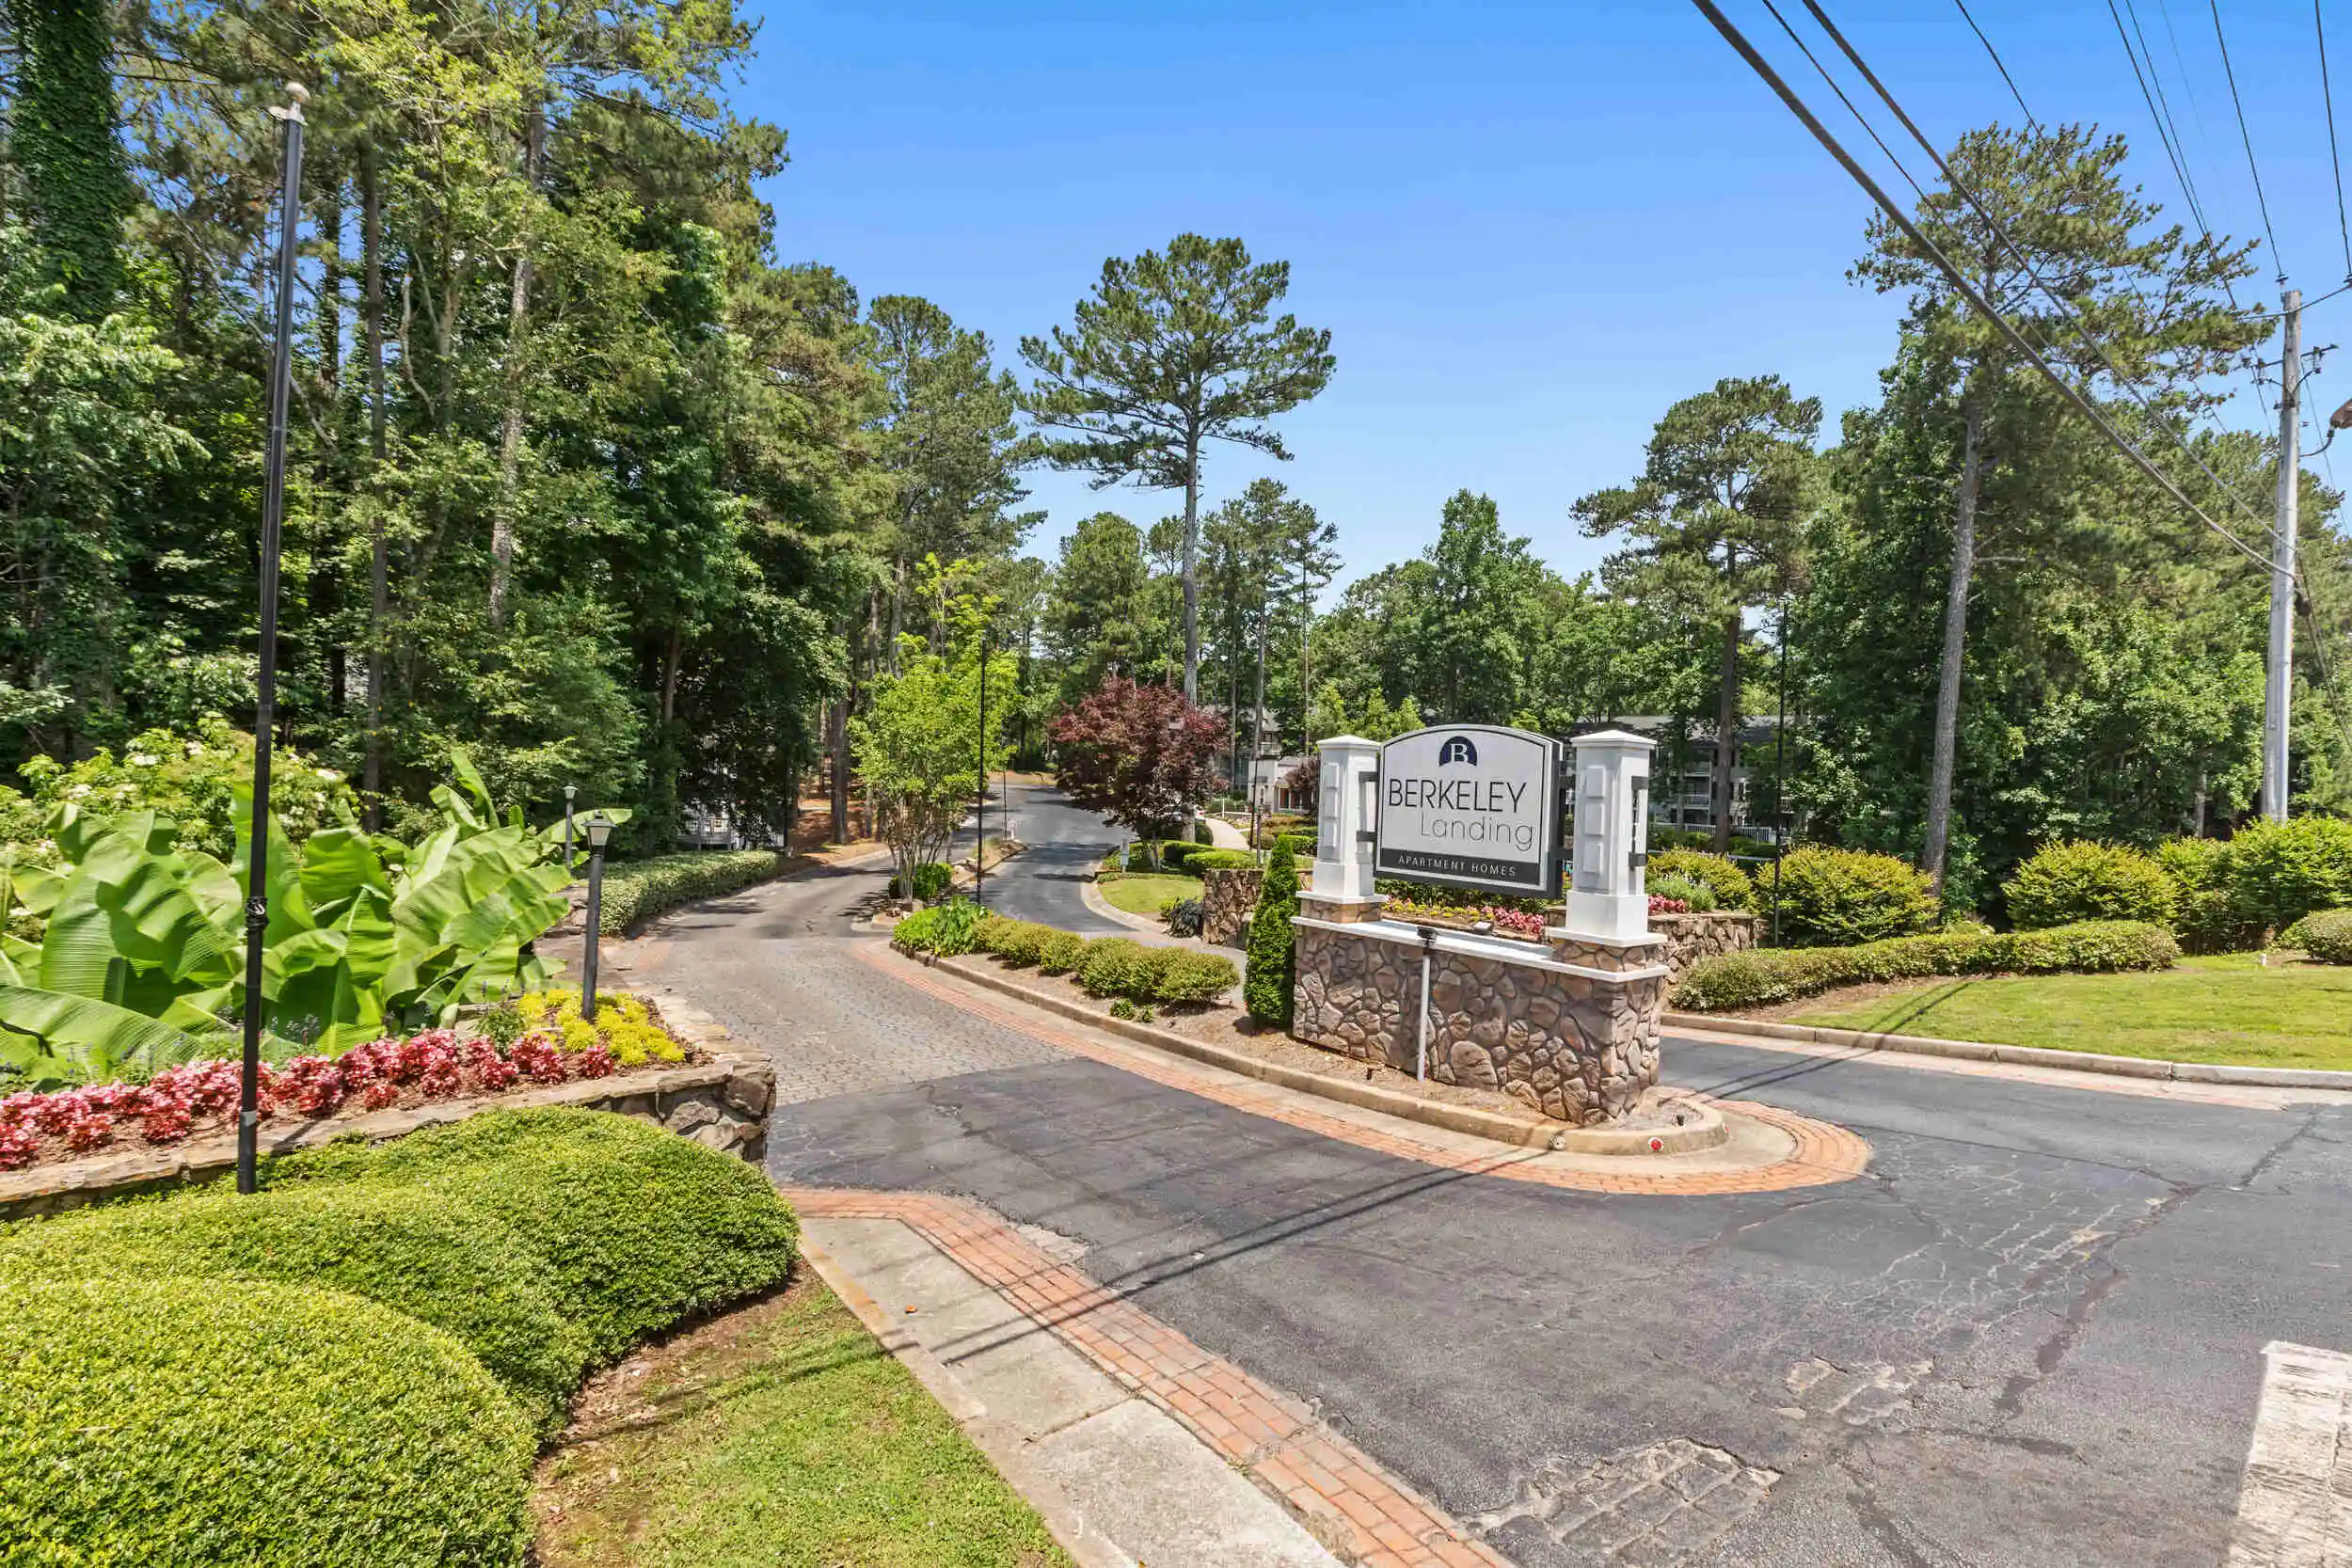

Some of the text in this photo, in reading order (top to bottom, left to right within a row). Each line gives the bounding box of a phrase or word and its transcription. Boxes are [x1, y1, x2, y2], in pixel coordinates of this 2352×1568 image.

[1389, 778, 1527, 814] BERKELEY
[1421, 813, 1533, 851] Landing
[1398, 855, 1517, 877] APARTMENT HOMES
